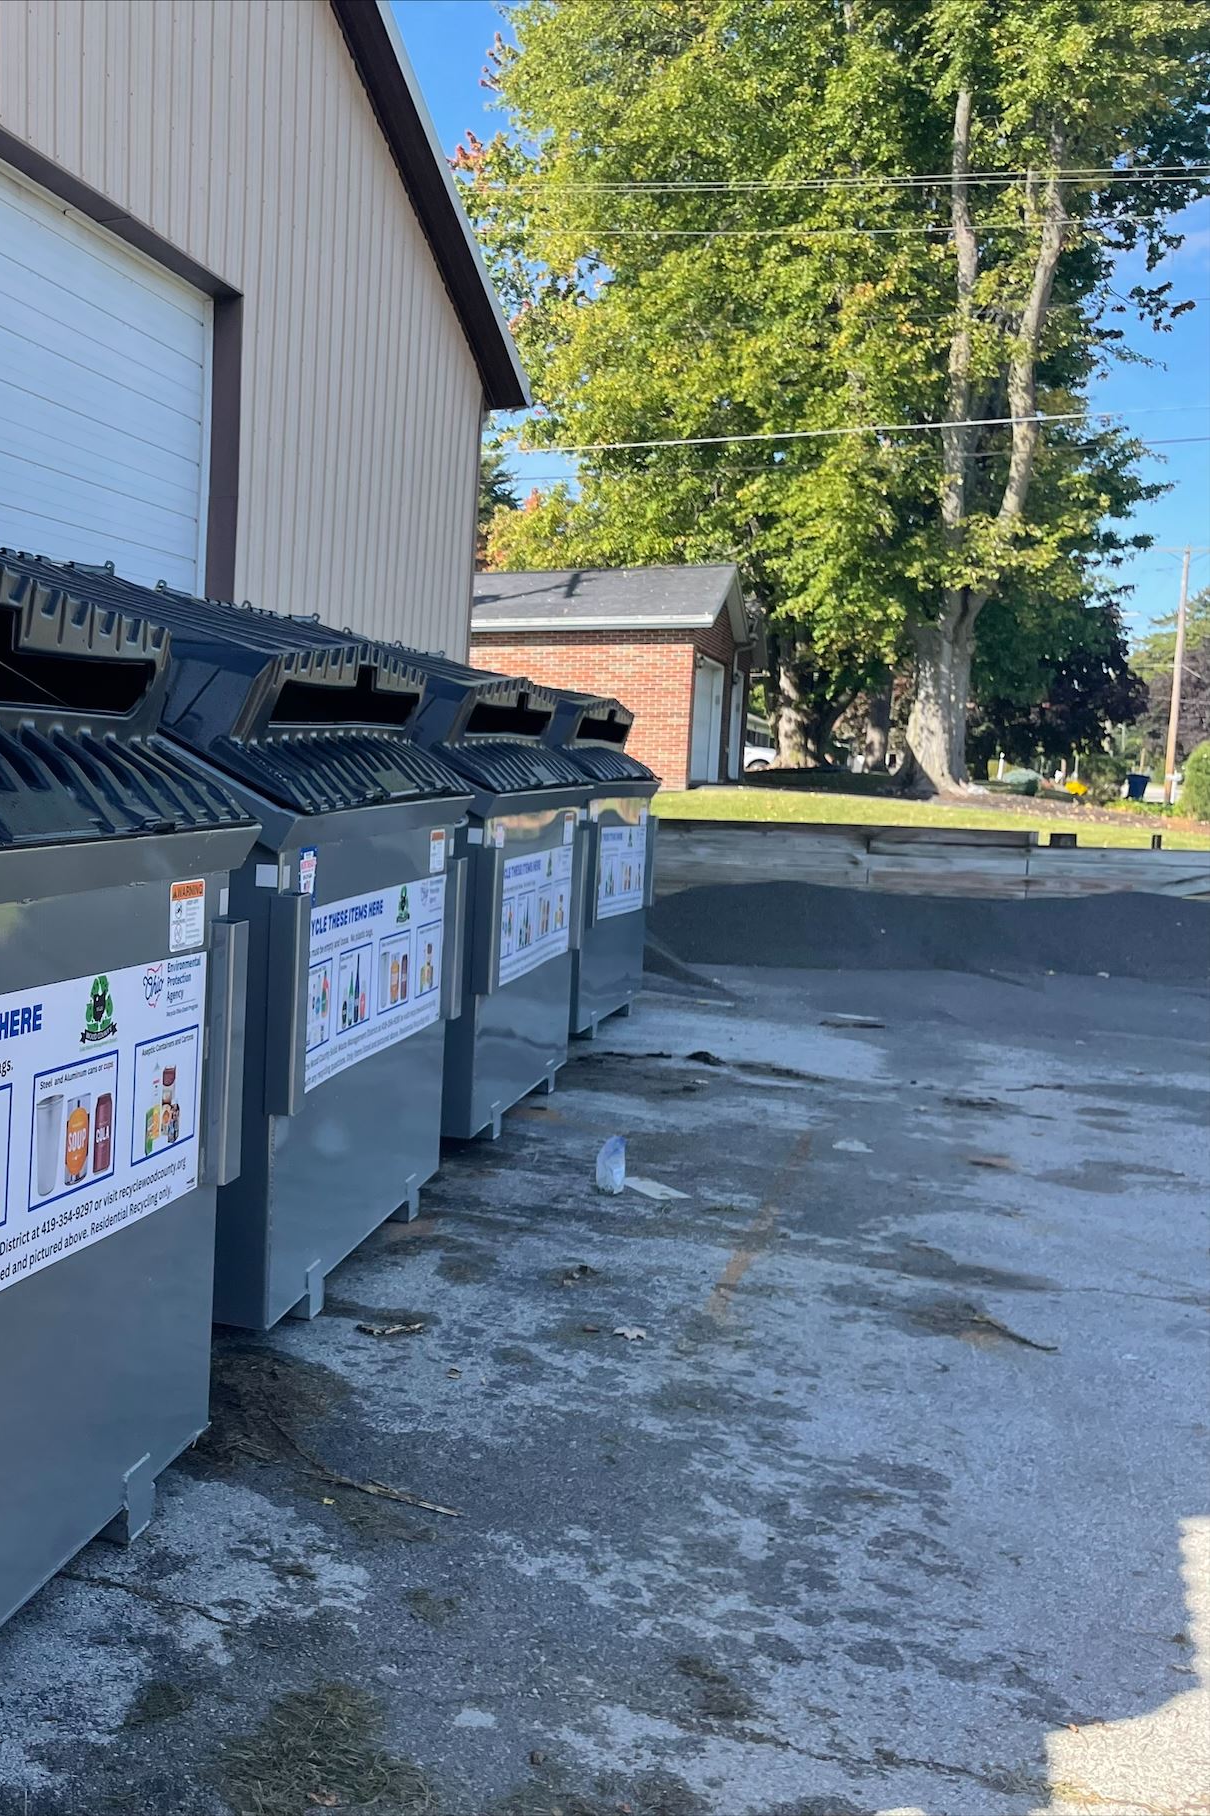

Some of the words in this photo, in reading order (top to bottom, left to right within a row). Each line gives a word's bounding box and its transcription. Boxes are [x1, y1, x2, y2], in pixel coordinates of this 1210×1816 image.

[328, 910, 348, 931] THESE
[348, 904, 368, 925] ITEMS
[368, 900, 383, 918] HERE
[167, 955, 201, 973] Environmental
[142, 975, 164, 1001] Ohio
[167, 973, 191, 987] Protection
[166, 989, 184, 1003] Agency
[156, 1040, 174, 1052] Containers
[174, 1037, 182, 1045] and
[40, 1079, 53, 1090] Steel
[54, 1075, 64, 1086] and
[64, 1069, 88, 1082] Aluminum
[88, 1066, 98, 1076] cans
[104, 1061, 114, 1071] cups
[68, 1127, 87, 1153] SOUP
[95, 1125, 110, 1143] COLA
[0, 1233, 30, 1256] District
[31, 1228, 40, 1242] at
[41, 1201, 93, 1235] 419-354-9297
[94, 1200, 102, 1211] or
[103, 1191, 118, 1206] visit
[118, 1158, 187, 1199] recyclewoodcounty.org
[12, 1254, 28, 1274] and
[29, 1237, 63, 1269] pictured
[64, 1227, 89, 1248] above.
[90, 1208, 128, 1236] Residential
[129, 1191, 158, 1219] Recycling
[158, 1185, 173, 1201] only.
